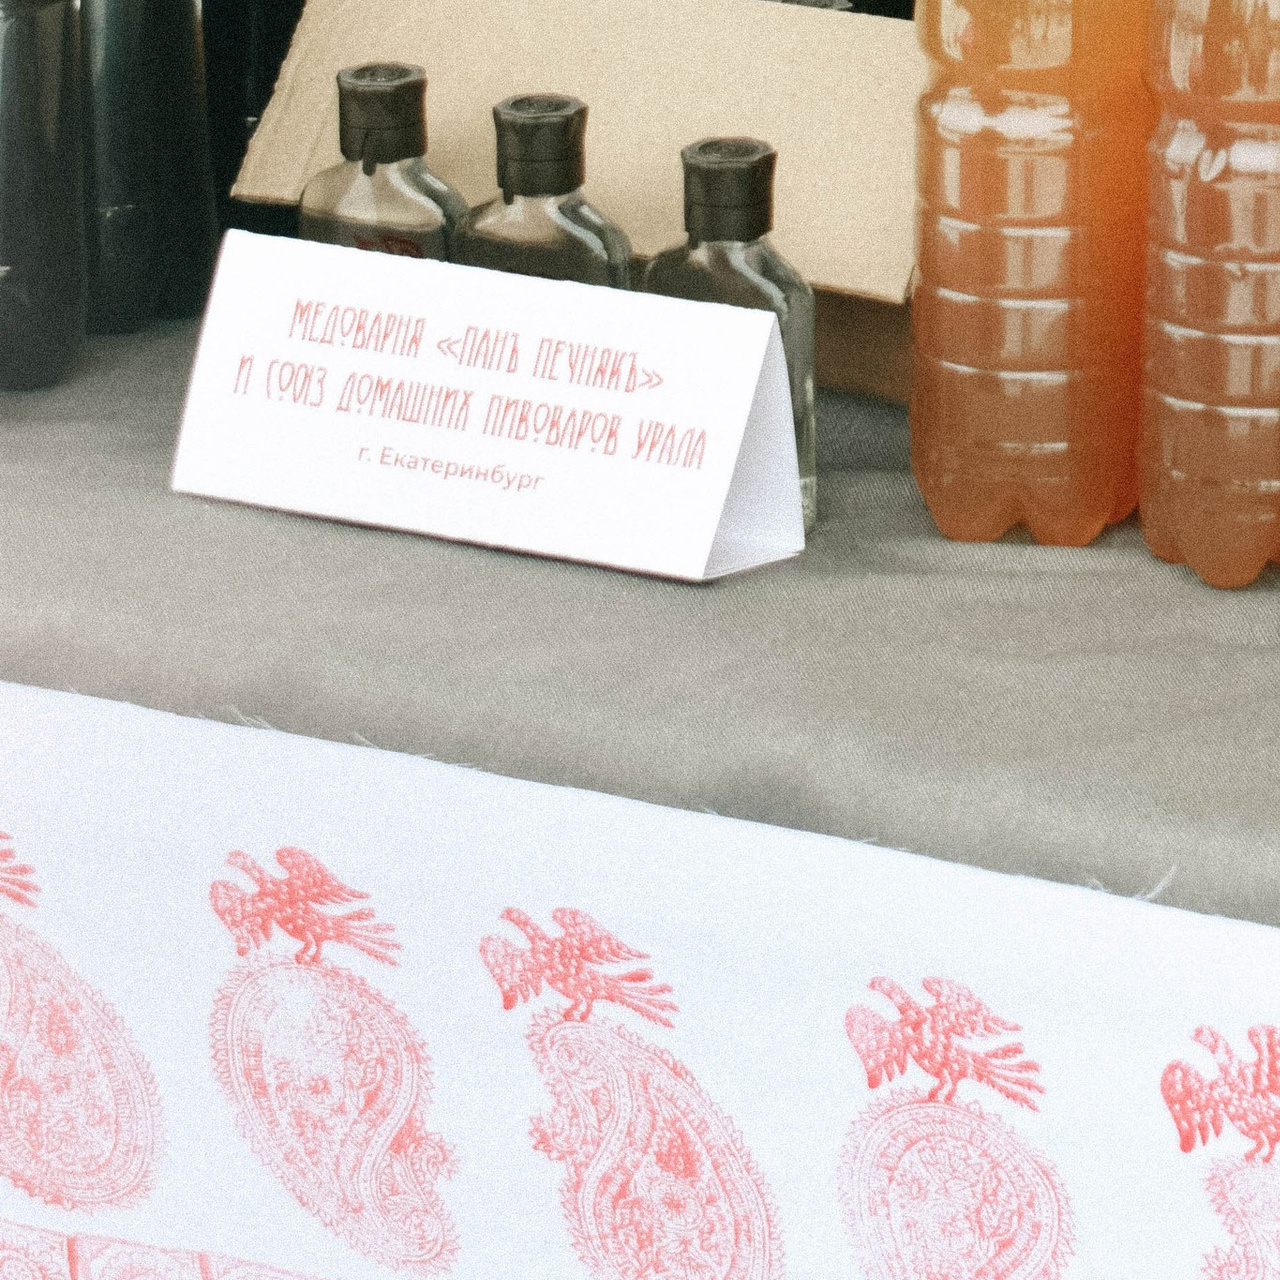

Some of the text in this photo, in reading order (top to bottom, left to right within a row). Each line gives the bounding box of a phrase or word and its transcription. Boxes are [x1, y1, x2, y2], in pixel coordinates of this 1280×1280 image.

[289, 298, 664, 393] МЕДОВАРНЯ «ПАНЪ ПЕЧНЯКЪ»
[233, 354, 707, 469] И СОЮЗ ДОМАШНИХ ПИВОВАРОВ УРАЛА
[358, 446, 545, 492] г. Екатеринбург
